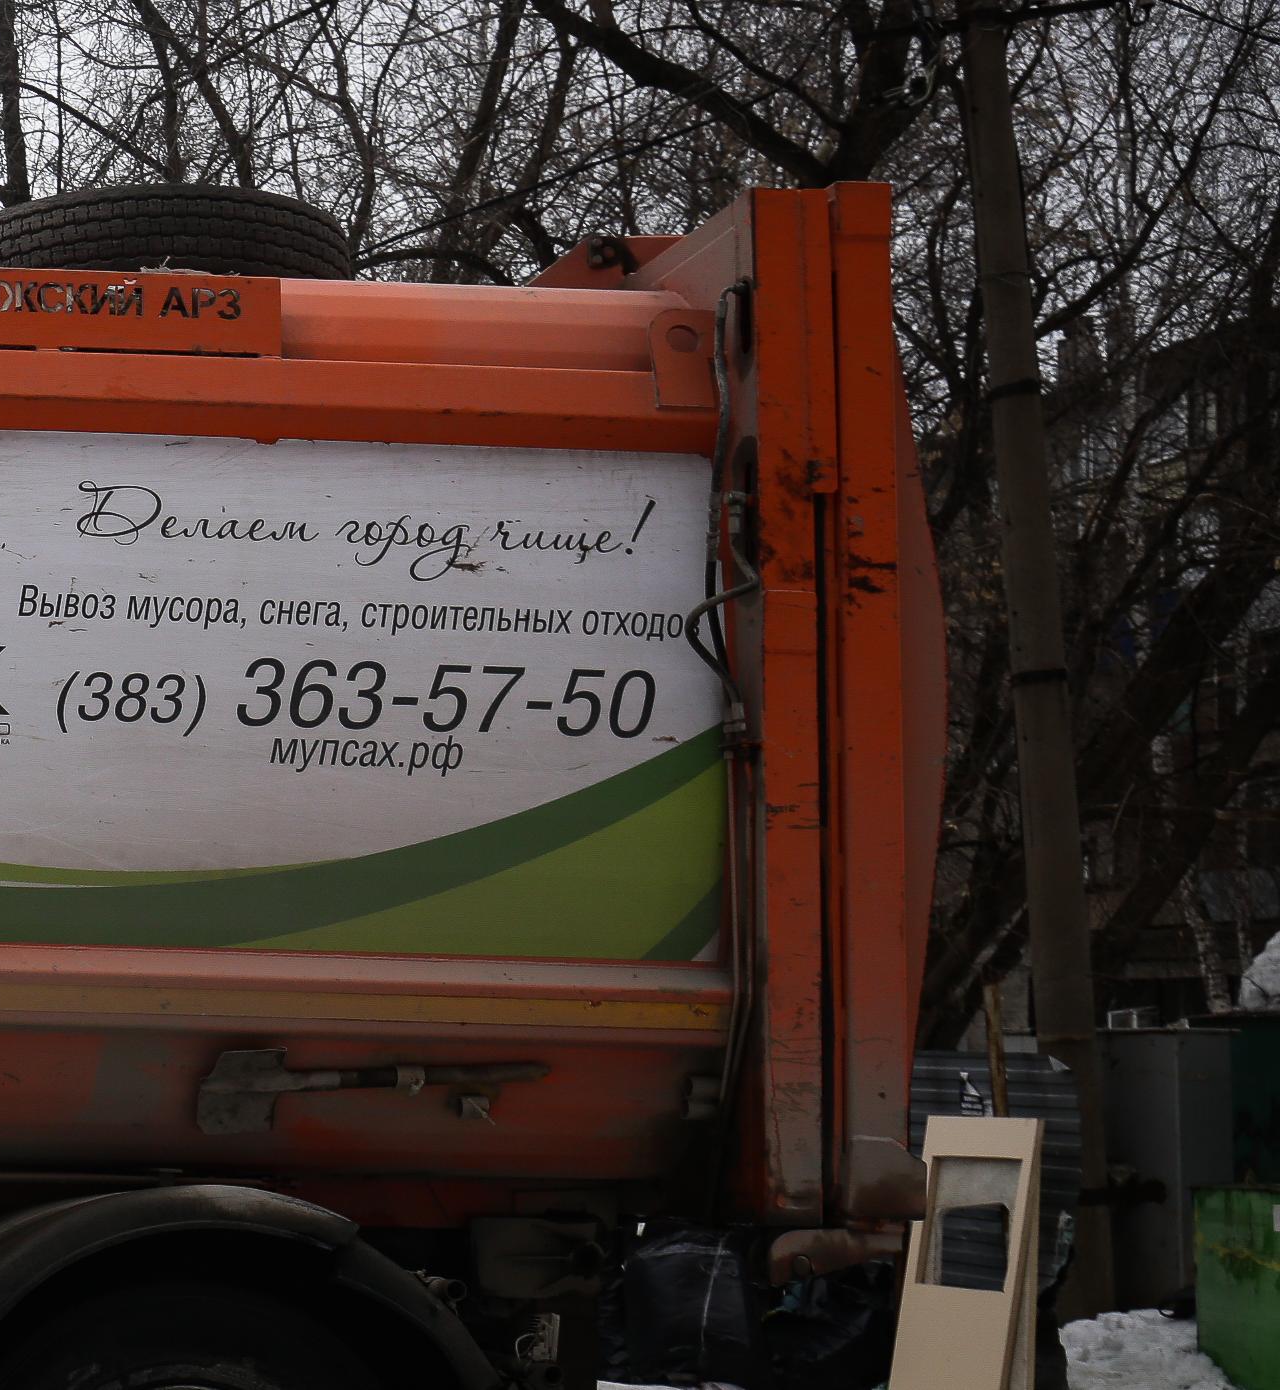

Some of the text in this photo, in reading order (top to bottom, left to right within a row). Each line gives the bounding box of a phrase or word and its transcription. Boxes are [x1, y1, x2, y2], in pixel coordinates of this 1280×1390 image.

[159, 287, 242, 320] АРЗ
[77, 481, 656, 581] Делаем город чище!
[18, 584, 116, 619] Вывоз
[127, 594, 247, 630] мусора,
[259, 599, 349, 632] снега,
[361, 601, 572, 635] строительных
[56, 657, 656, 738] (383) 363-57-50
[269, 735, 463, 777] мупсах.рф
